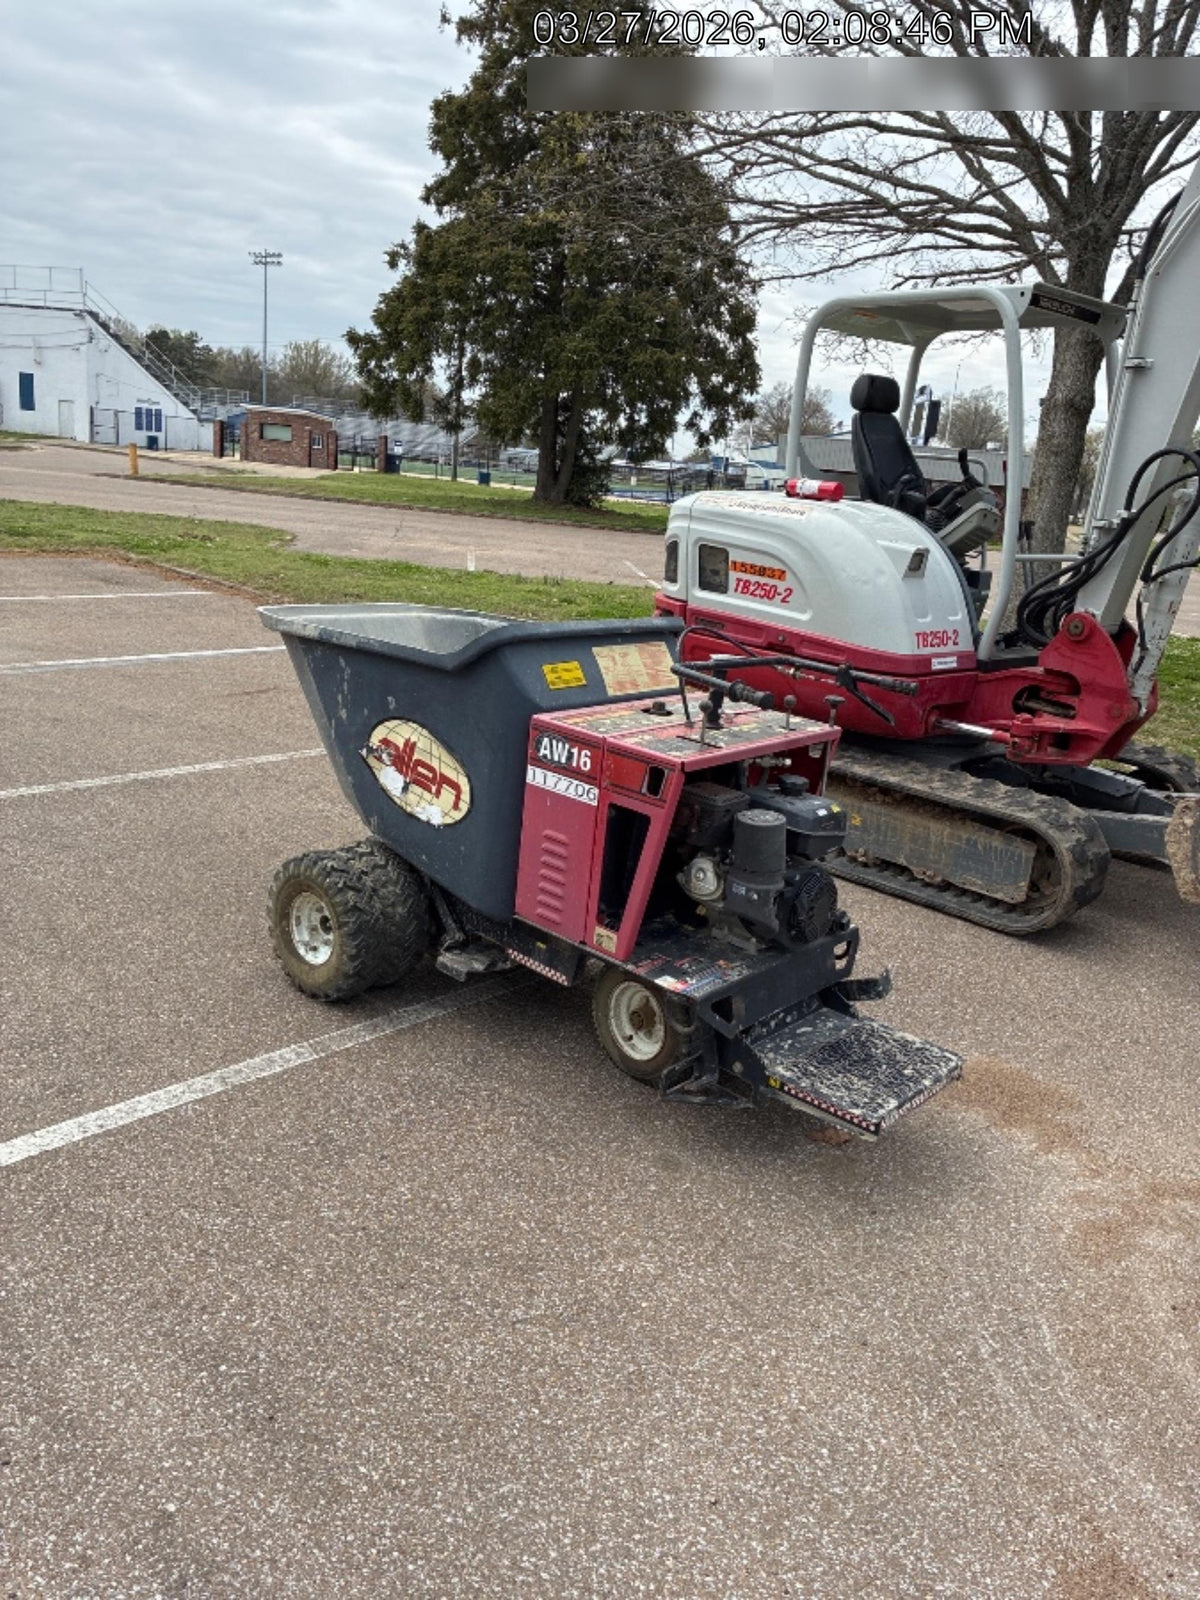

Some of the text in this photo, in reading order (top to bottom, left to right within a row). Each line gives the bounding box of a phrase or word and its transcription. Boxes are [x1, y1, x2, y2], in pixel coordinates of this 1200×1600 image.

[734, 577, 793, 604] TB250-2
[915, 629, 959, 649] TB250-2
[529, 767, 597, 802] 117706
